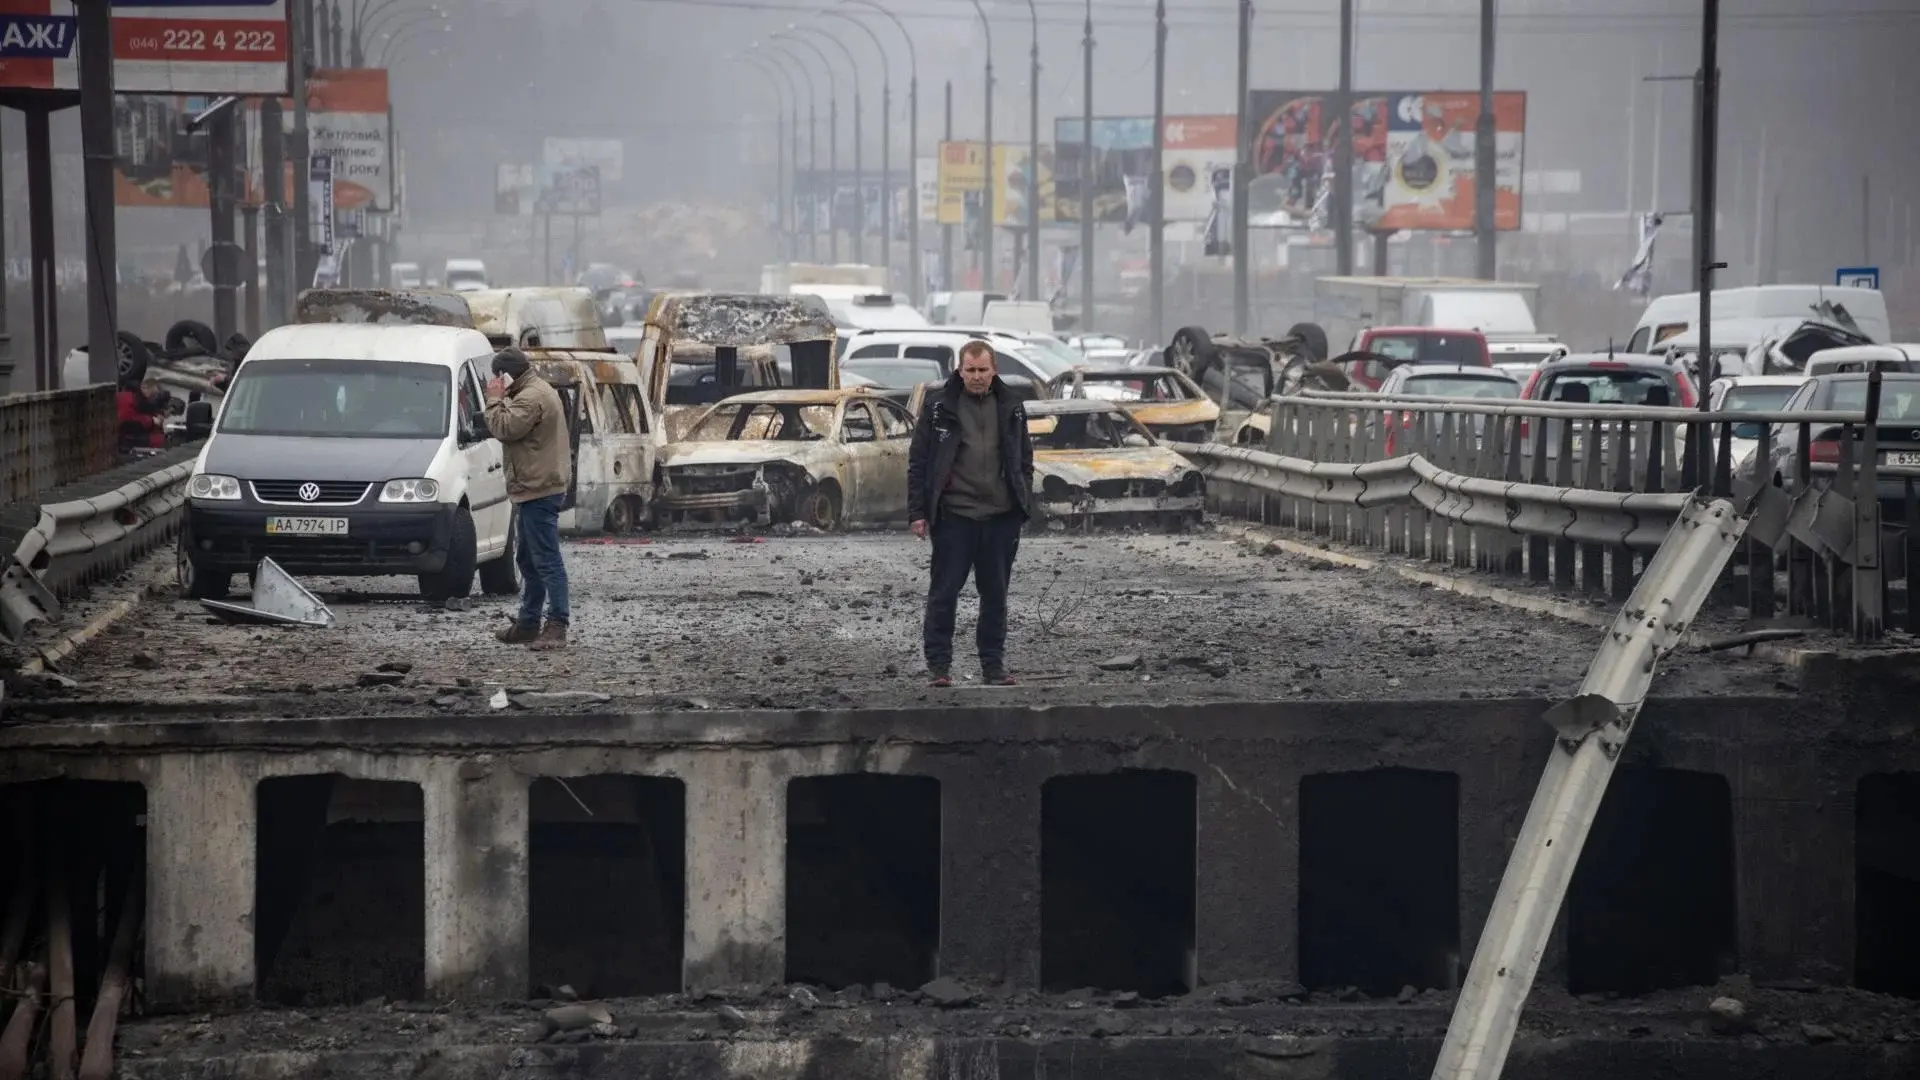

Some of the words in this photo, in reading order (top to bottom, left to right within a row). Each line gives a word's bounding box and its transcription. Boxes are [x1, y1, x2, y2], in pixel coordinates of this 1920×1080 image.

[0, 22, 66, 51] АЖ!
[129, 37, 158, 50] (044)
[163, 28, 206, 50] 222
[212, 30, 227, 50] 4
[234, 31, 276, 51] 222
[275, 519, 293, 532] AA
[296, 519, 326, 533] 7974
